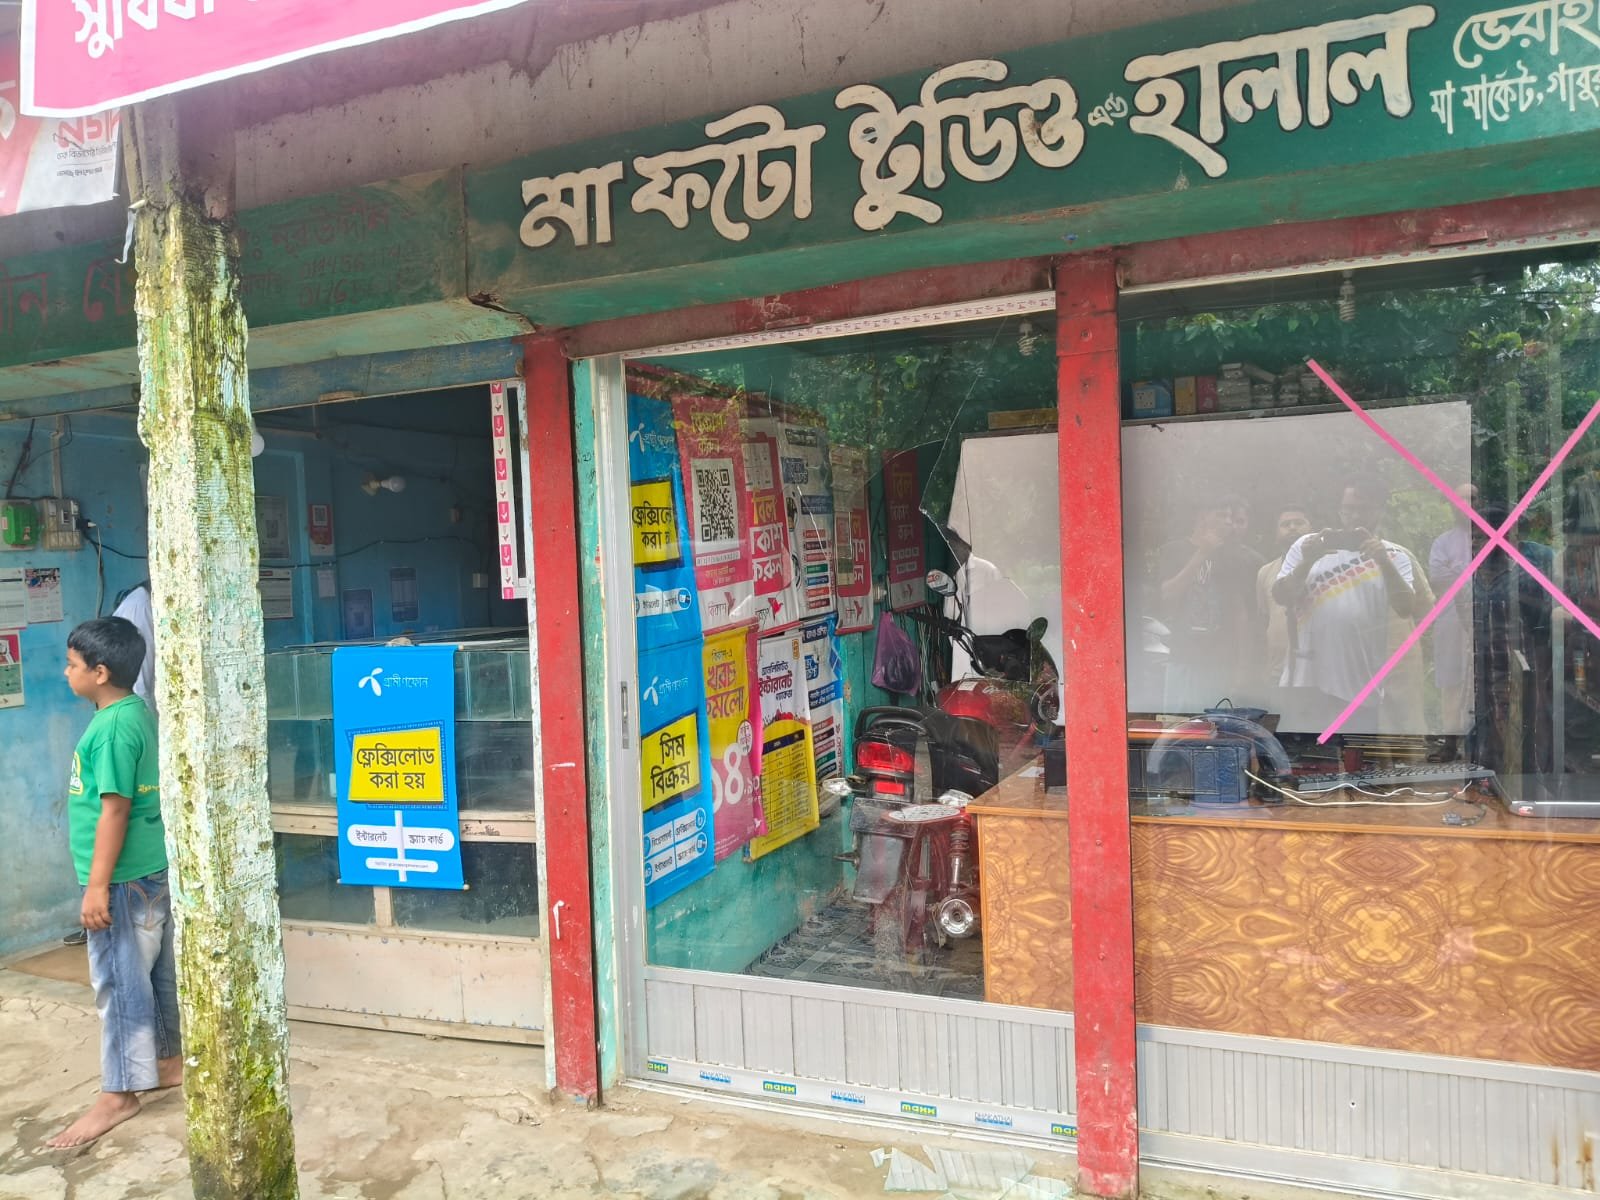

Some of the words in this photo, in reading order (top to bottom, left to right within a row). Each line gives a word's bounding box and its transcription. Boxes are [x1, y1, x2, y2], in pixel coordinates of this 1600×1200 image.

[1429, 80, 1456, 134] মা
[519, 160, 624, 248] মা
[631, 104, 826, 241] ফটো
[1123, 4, 1437, 178] হালাল
[383, 673, 429, 689] গ্রামীণফোন
[356, 743, 436, 769] ফ্লেক্সিলোড
[659, 732, 686, 765] সিম
[369, 771, 399, 790] করা
[403, 771, 426, 790] হয়
[650, 760, 691, 799] বিক্রয়
[355, 830, 388, 842] ইন্টারনেট
[427, 833, 444, 845] কার্ড
